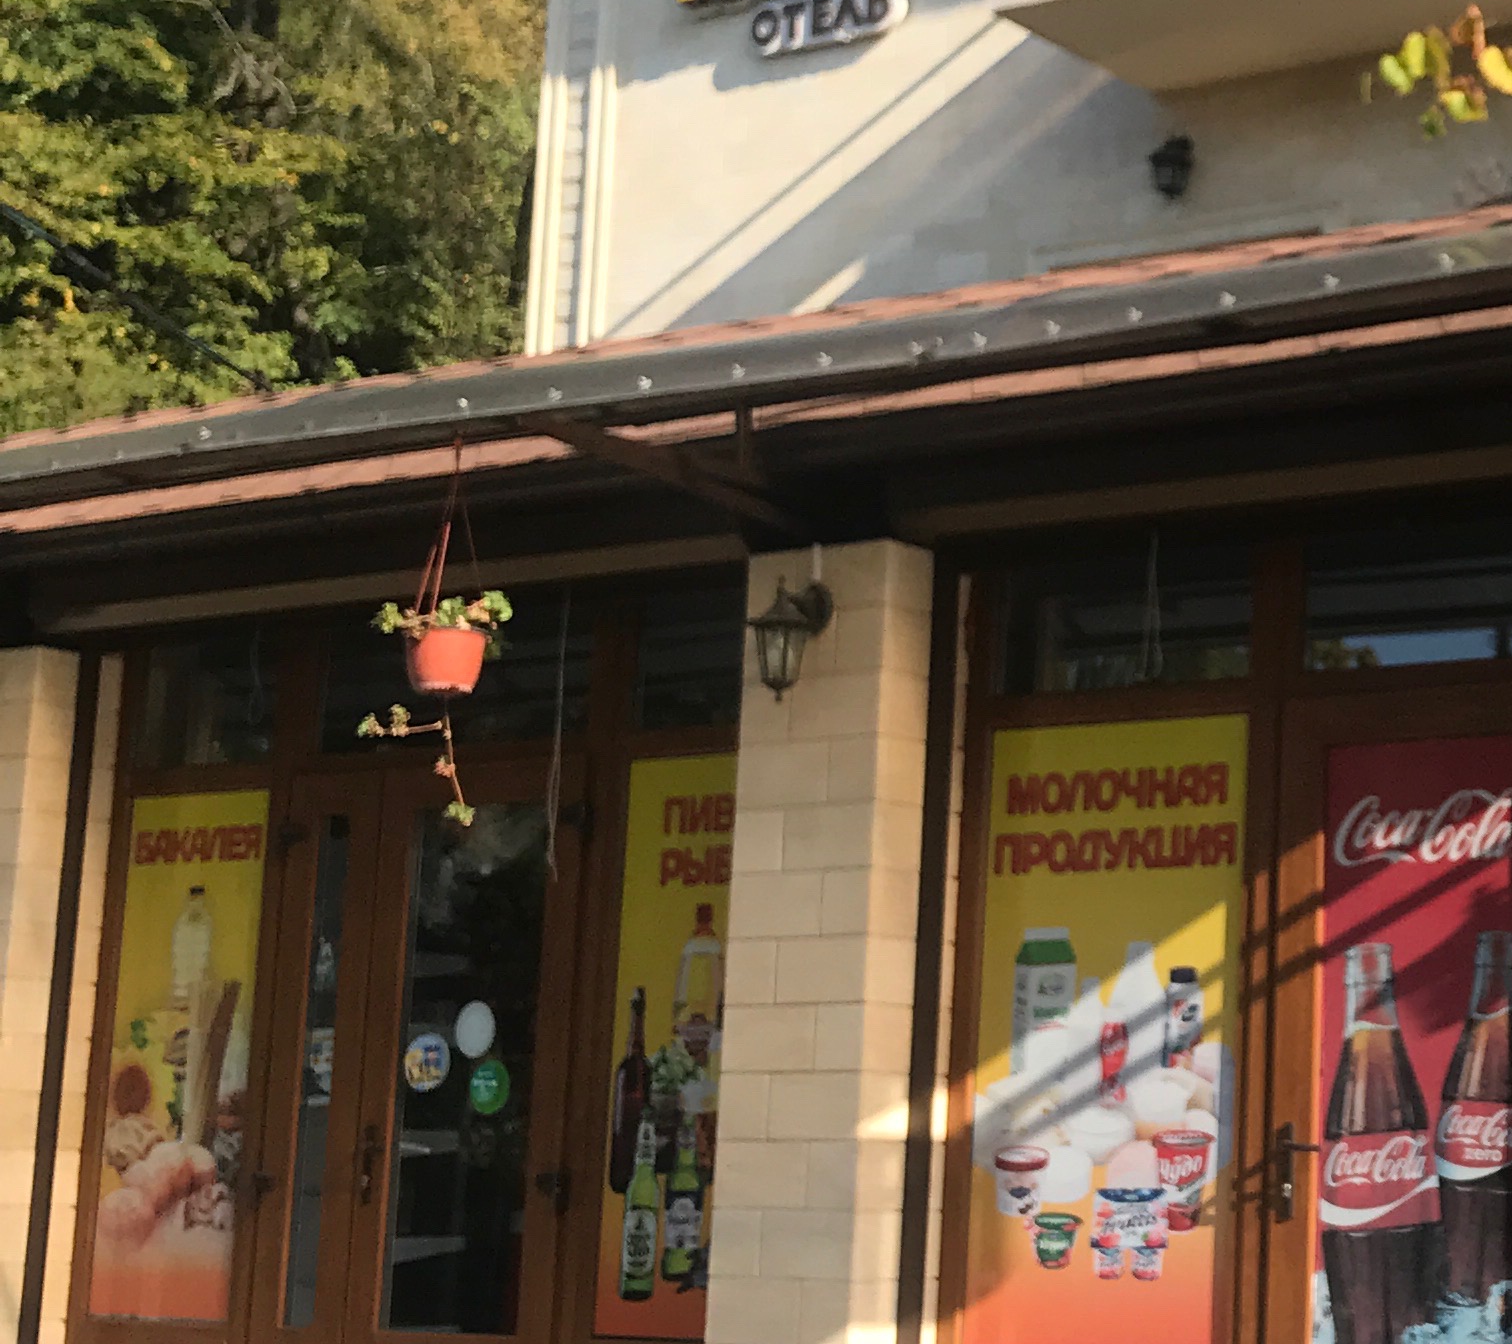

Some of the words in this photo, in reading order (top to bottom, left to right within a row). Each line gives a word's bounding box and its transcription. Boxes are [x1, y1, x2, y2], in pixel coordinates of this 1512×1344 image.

[1006, 761, 1230, 816] МОЛОЧНАЯ
[662, 792, 737, 835] ПИВ
[659, 844, 734, 887] РЫБ
[993, 820, 1238, 877] ПРОДУКЦИЯ
